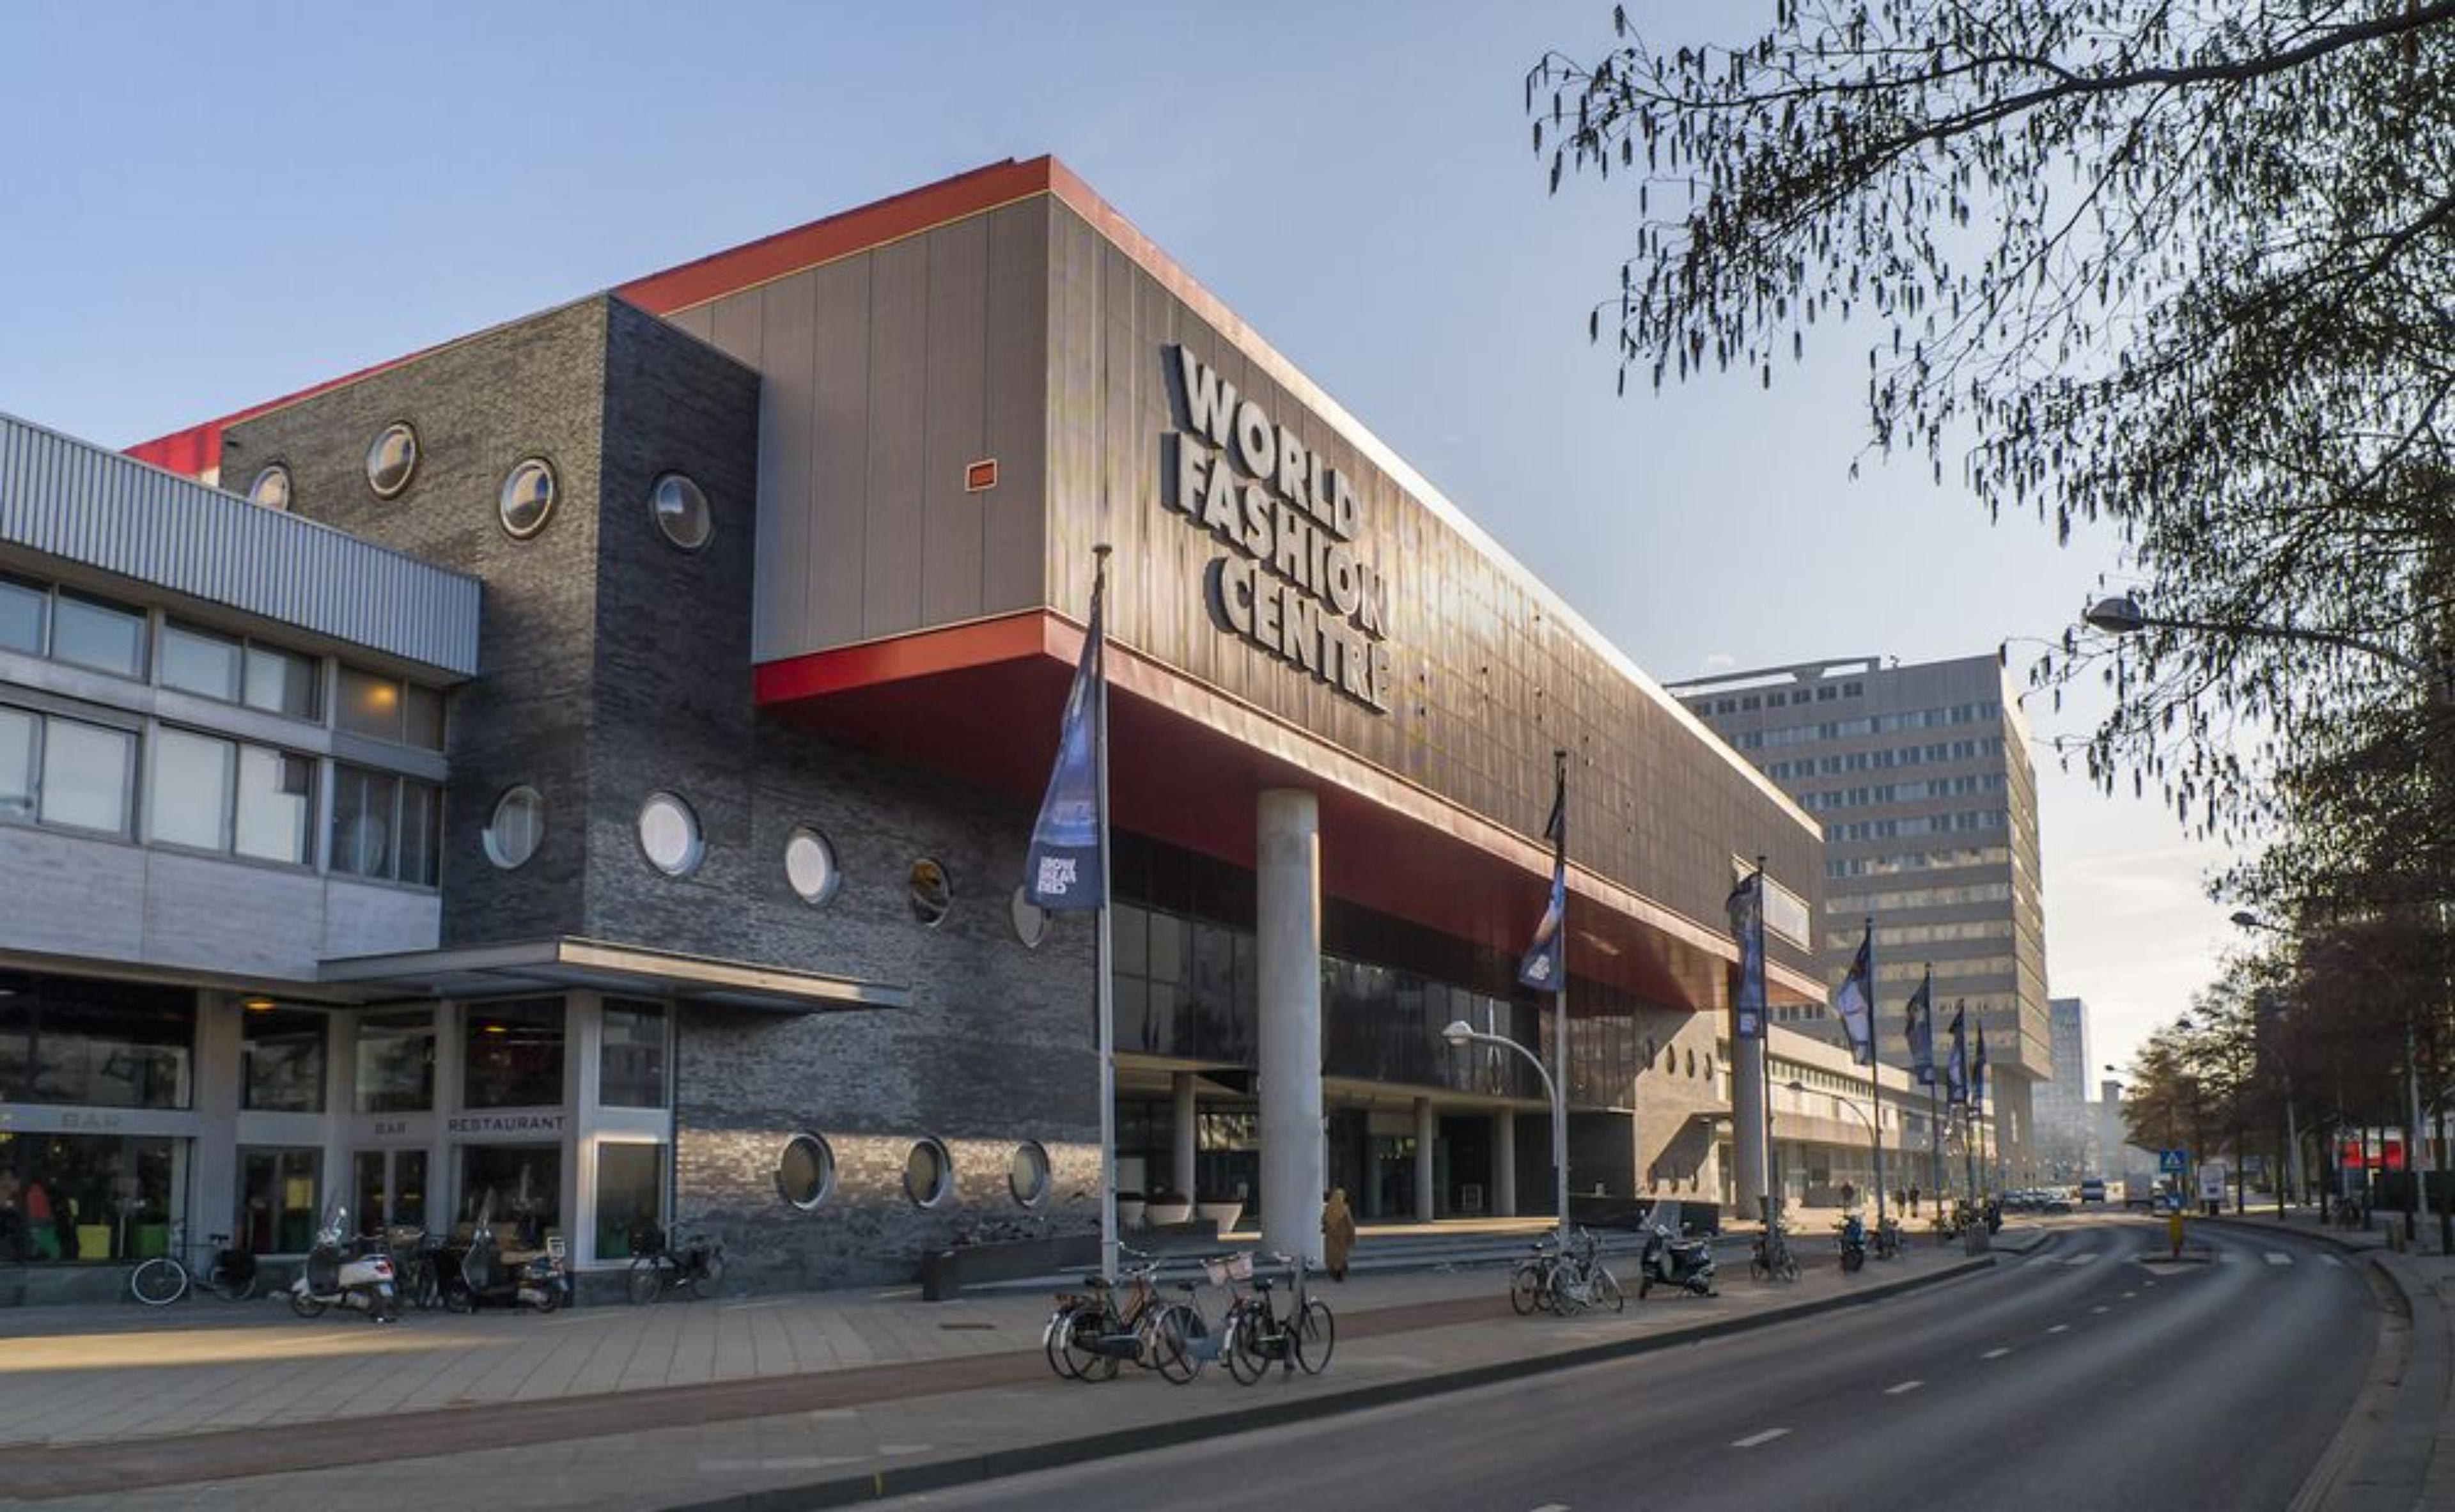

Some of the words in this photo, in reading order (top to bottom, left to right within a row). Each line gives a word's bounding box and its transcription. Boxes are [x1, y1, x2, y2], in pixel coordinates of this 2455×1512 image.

[1161, 343, 1360, 543] WORLD
[1161, 432, 1388, 641] FASHION
[1203, 556, 1391, 714] CENTRE
[61, 1112, 122, 1130] BAR
[375, 1121, 405, 1135] BAR
[448, 1116, 565, 1132] RESTAURANT
